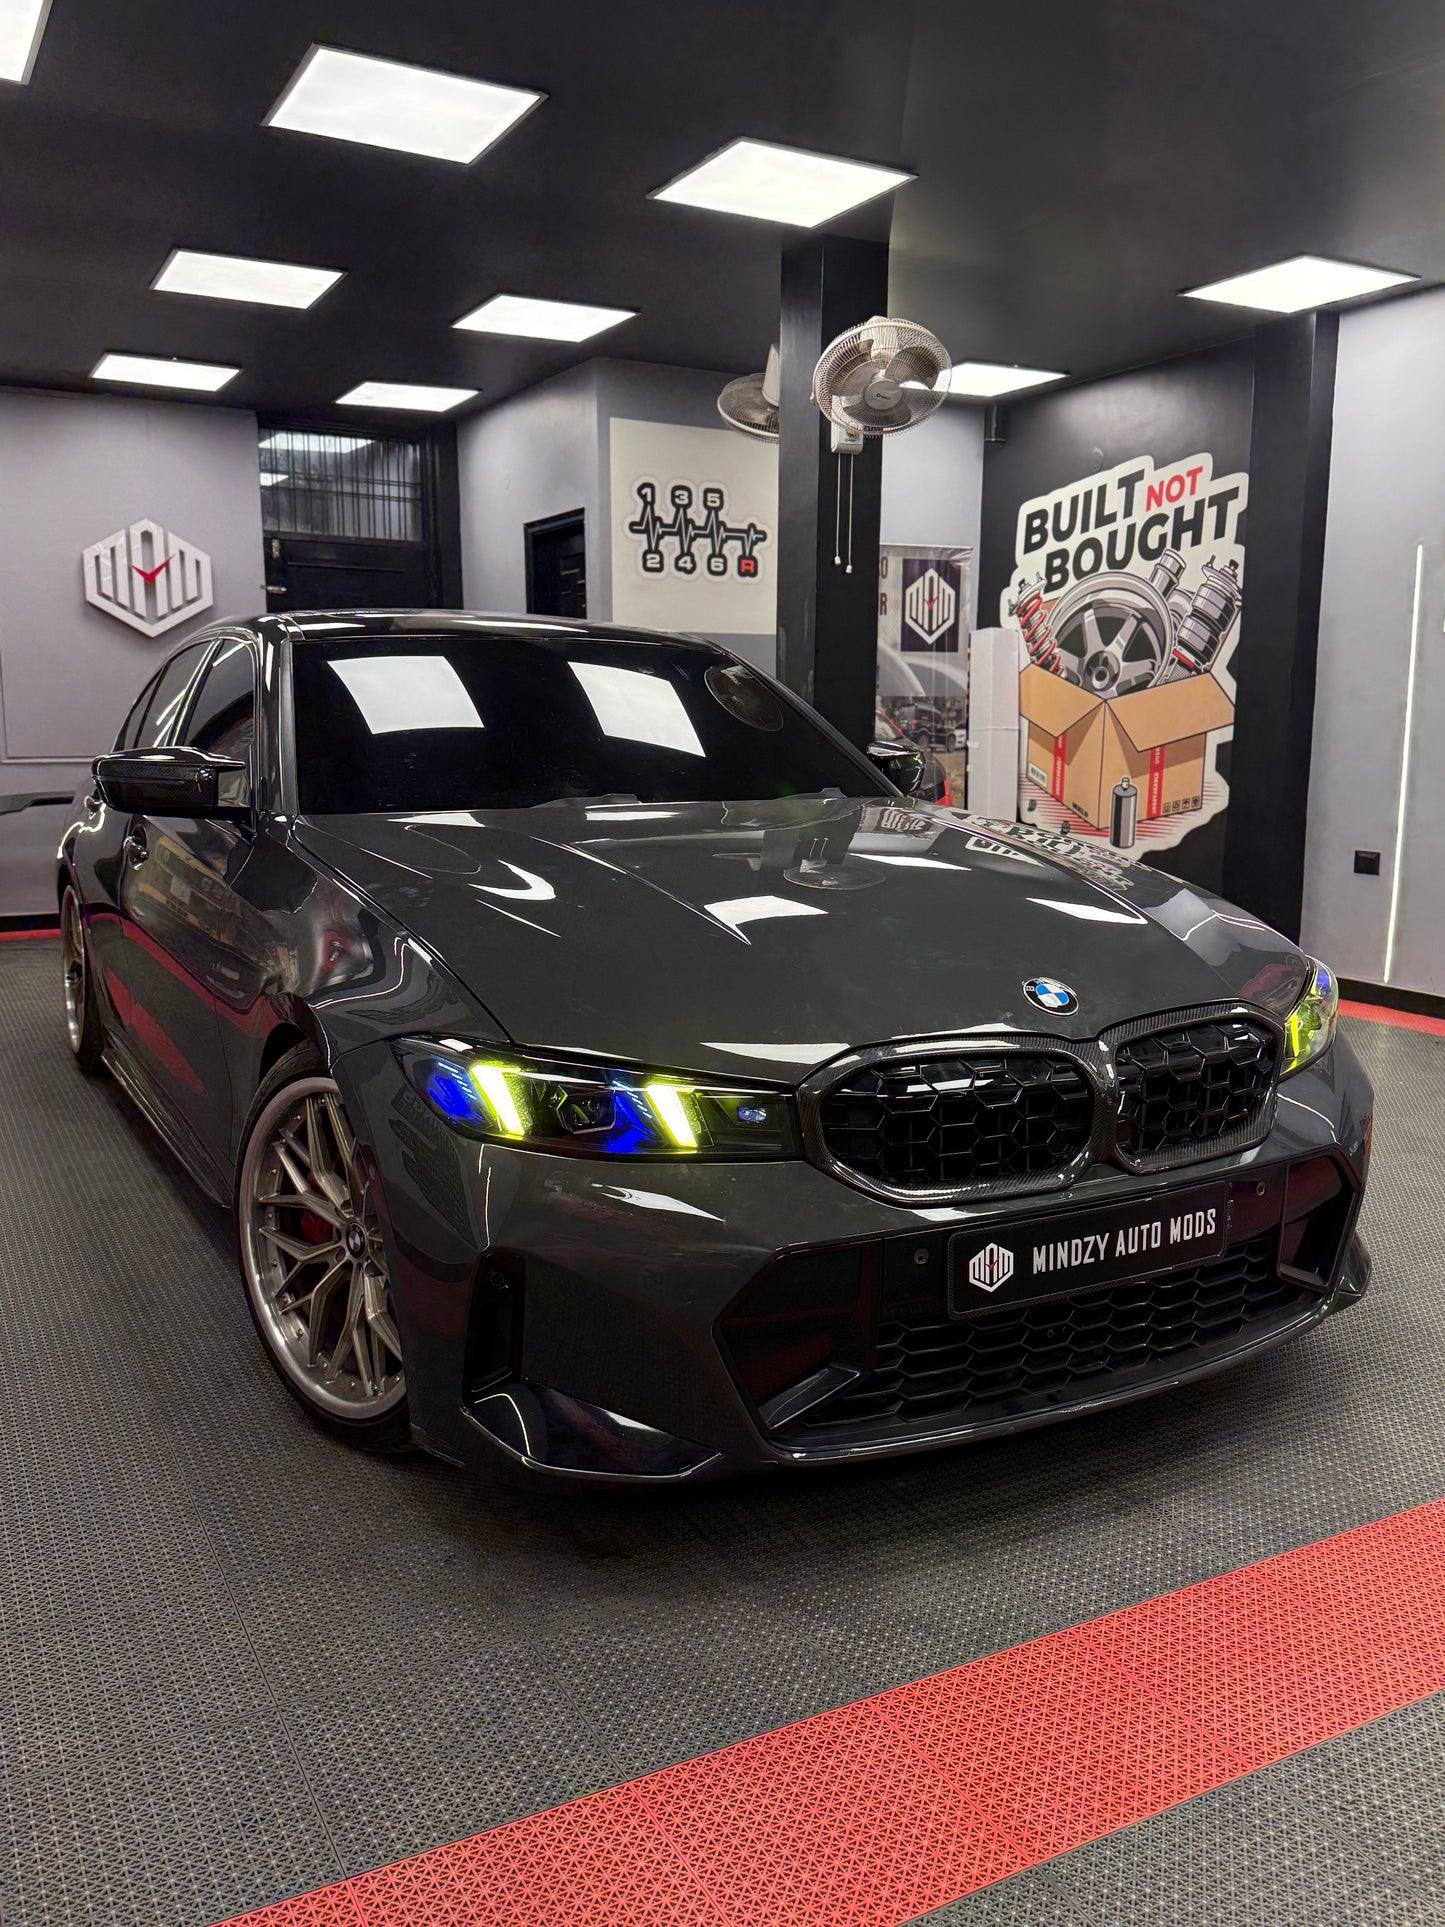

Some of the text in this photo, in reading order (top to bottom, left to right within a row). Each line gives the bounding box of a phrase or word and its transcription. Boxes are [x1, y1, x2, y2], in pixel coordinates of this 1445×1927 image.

[641, 487, 721, 507] 1 3 5
[1024, 466, 1203, 555] BUILT NOT
[646, 554, 755, 573] 2 4 6 R
[1043, 486, 1240, 594] BOUGHT
[1033, 1208, 1216, 1274] MINDZY AUTO MODS
